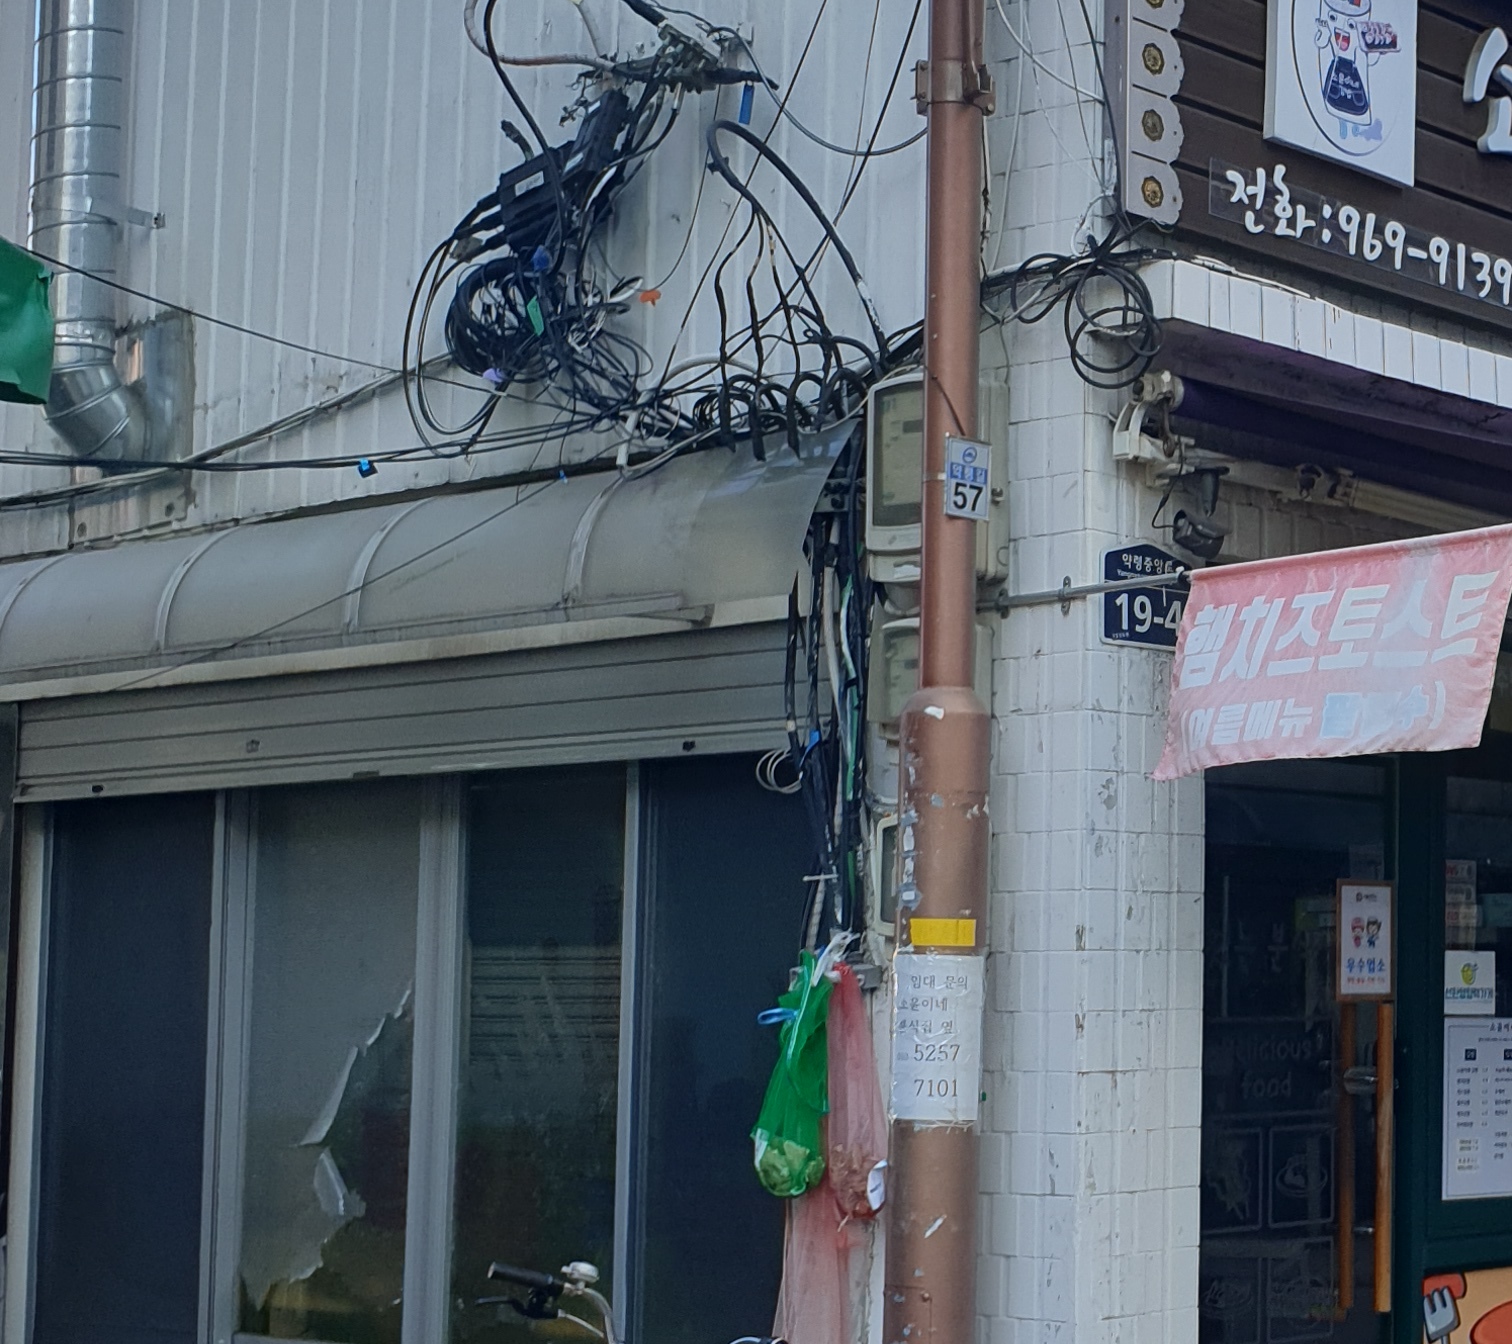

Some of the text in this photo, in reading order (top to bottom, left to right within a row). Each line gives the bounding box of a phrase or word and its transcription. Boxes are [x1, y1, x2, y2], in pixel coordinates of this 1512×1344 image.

[953, 481, 984, 513] 57
[1178, 570, 1501, 690] 햄치즈토스트
[911, 974, 969, 991] 임대 문의
[913, 1043, 961, 1063] 5257
[913, 1079, 959, 1098] 7101
